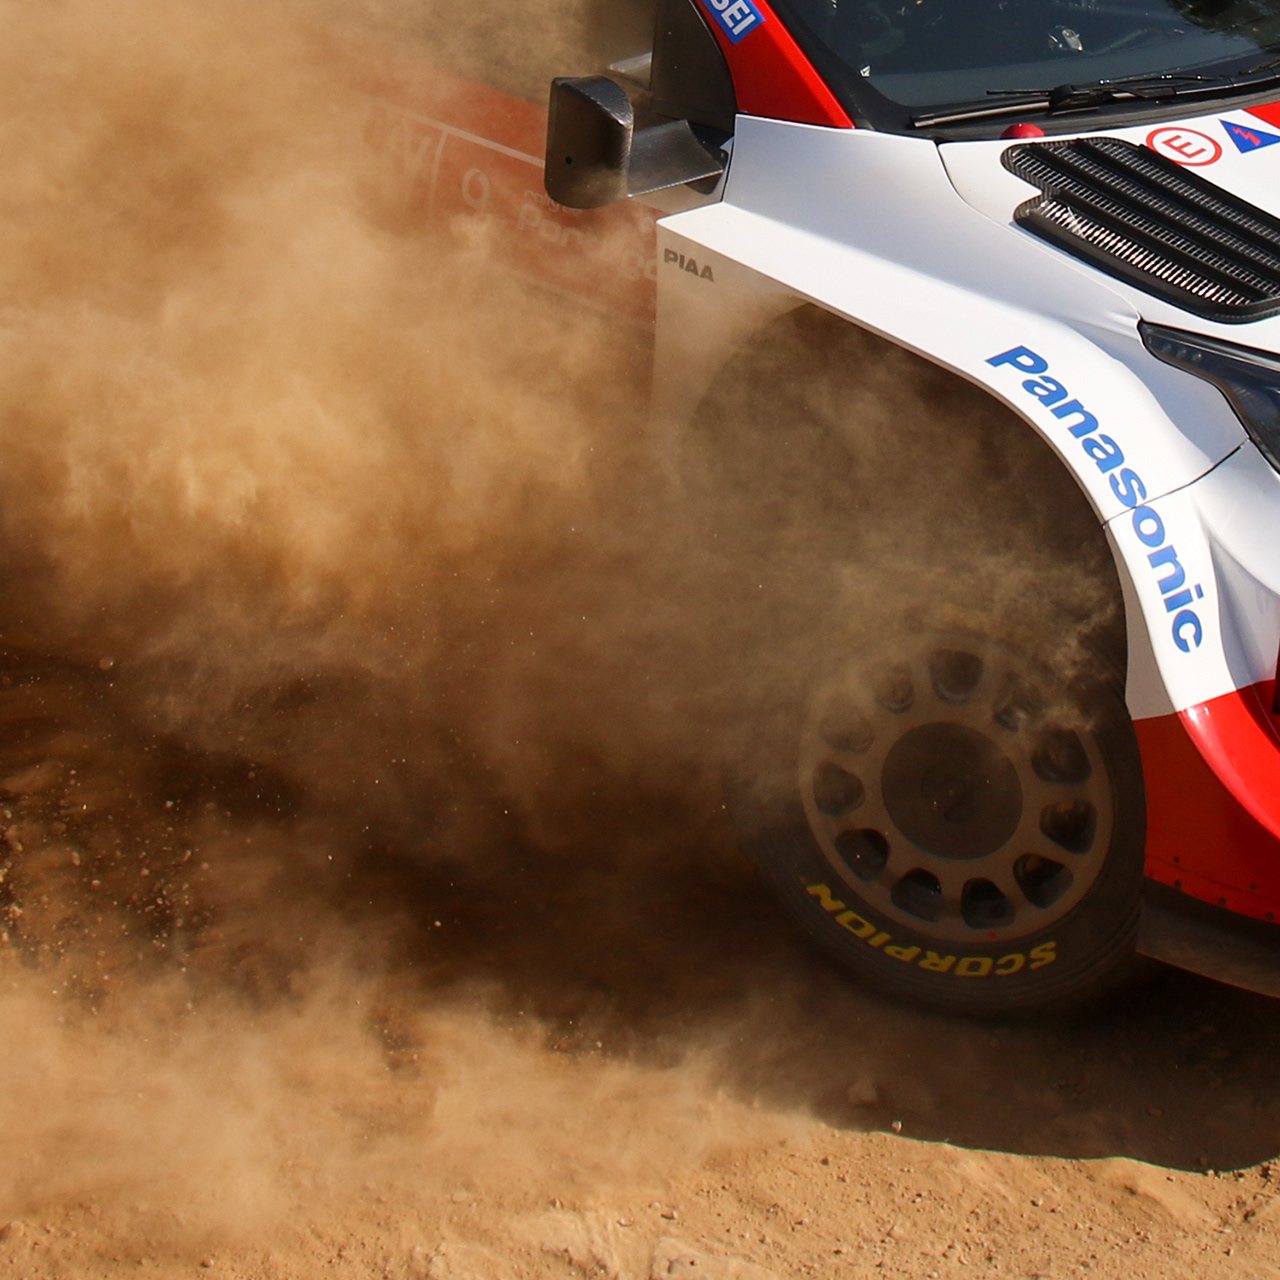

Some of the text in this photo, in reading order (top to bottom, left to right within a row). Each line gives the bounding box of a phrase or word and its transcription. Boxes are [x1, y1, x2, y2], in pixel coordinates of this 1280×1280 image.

[1161, 134, 1207, 159] E
[663, 247, 715, 282] PIAA
[985, 345, 1203, 653] Panasonic
[801, 877, 1058, 977] SCORPION
